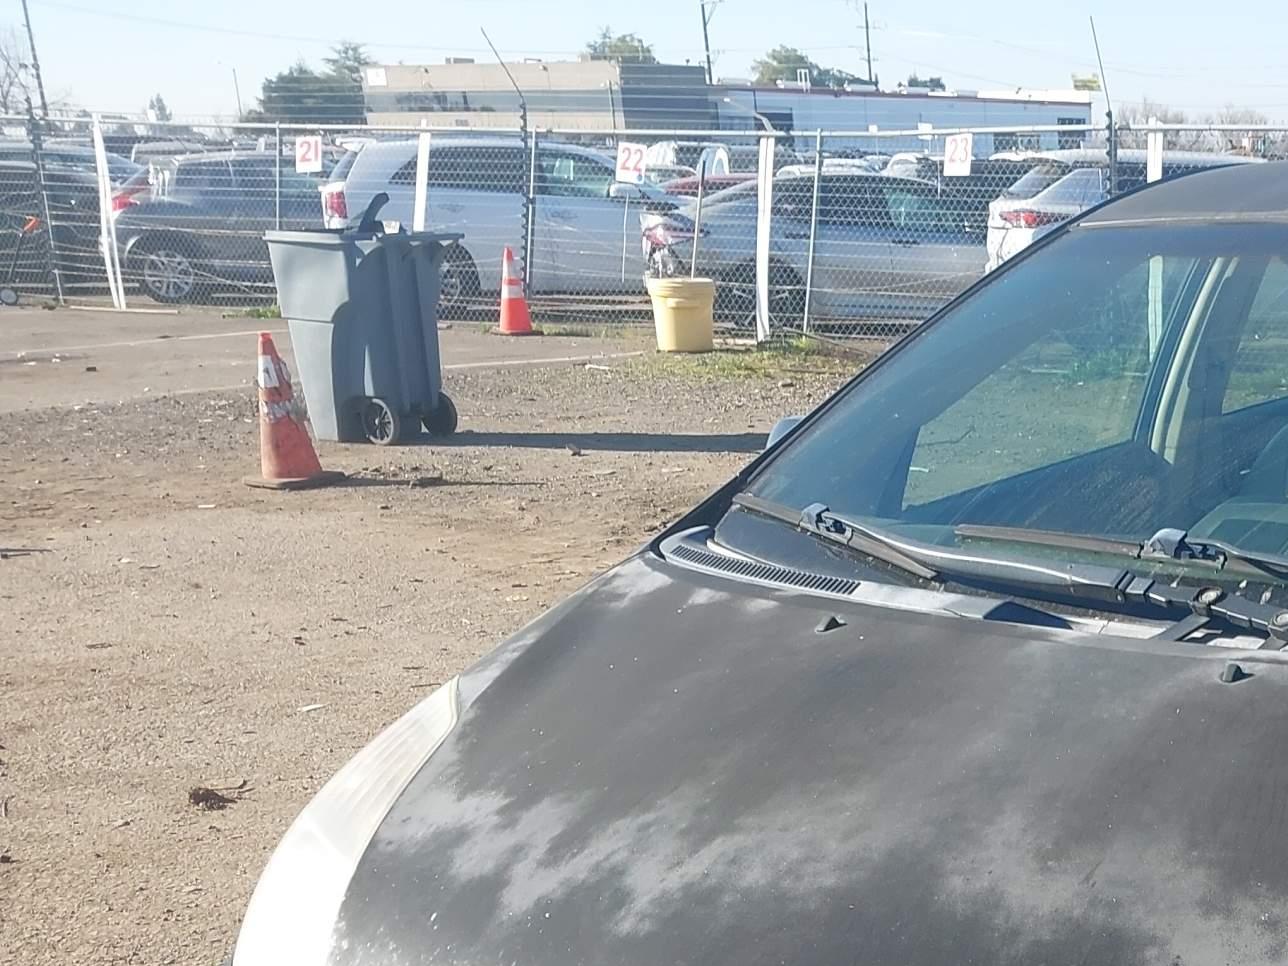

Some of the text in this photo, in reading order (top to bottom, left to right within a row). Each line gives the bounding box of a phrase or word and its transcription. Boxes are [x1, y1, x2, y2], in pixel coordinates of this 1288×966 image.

[299, 139, 319, 162] 21
[620, 147, 644, 171] 22
[949, 137, 969, 163] 23
